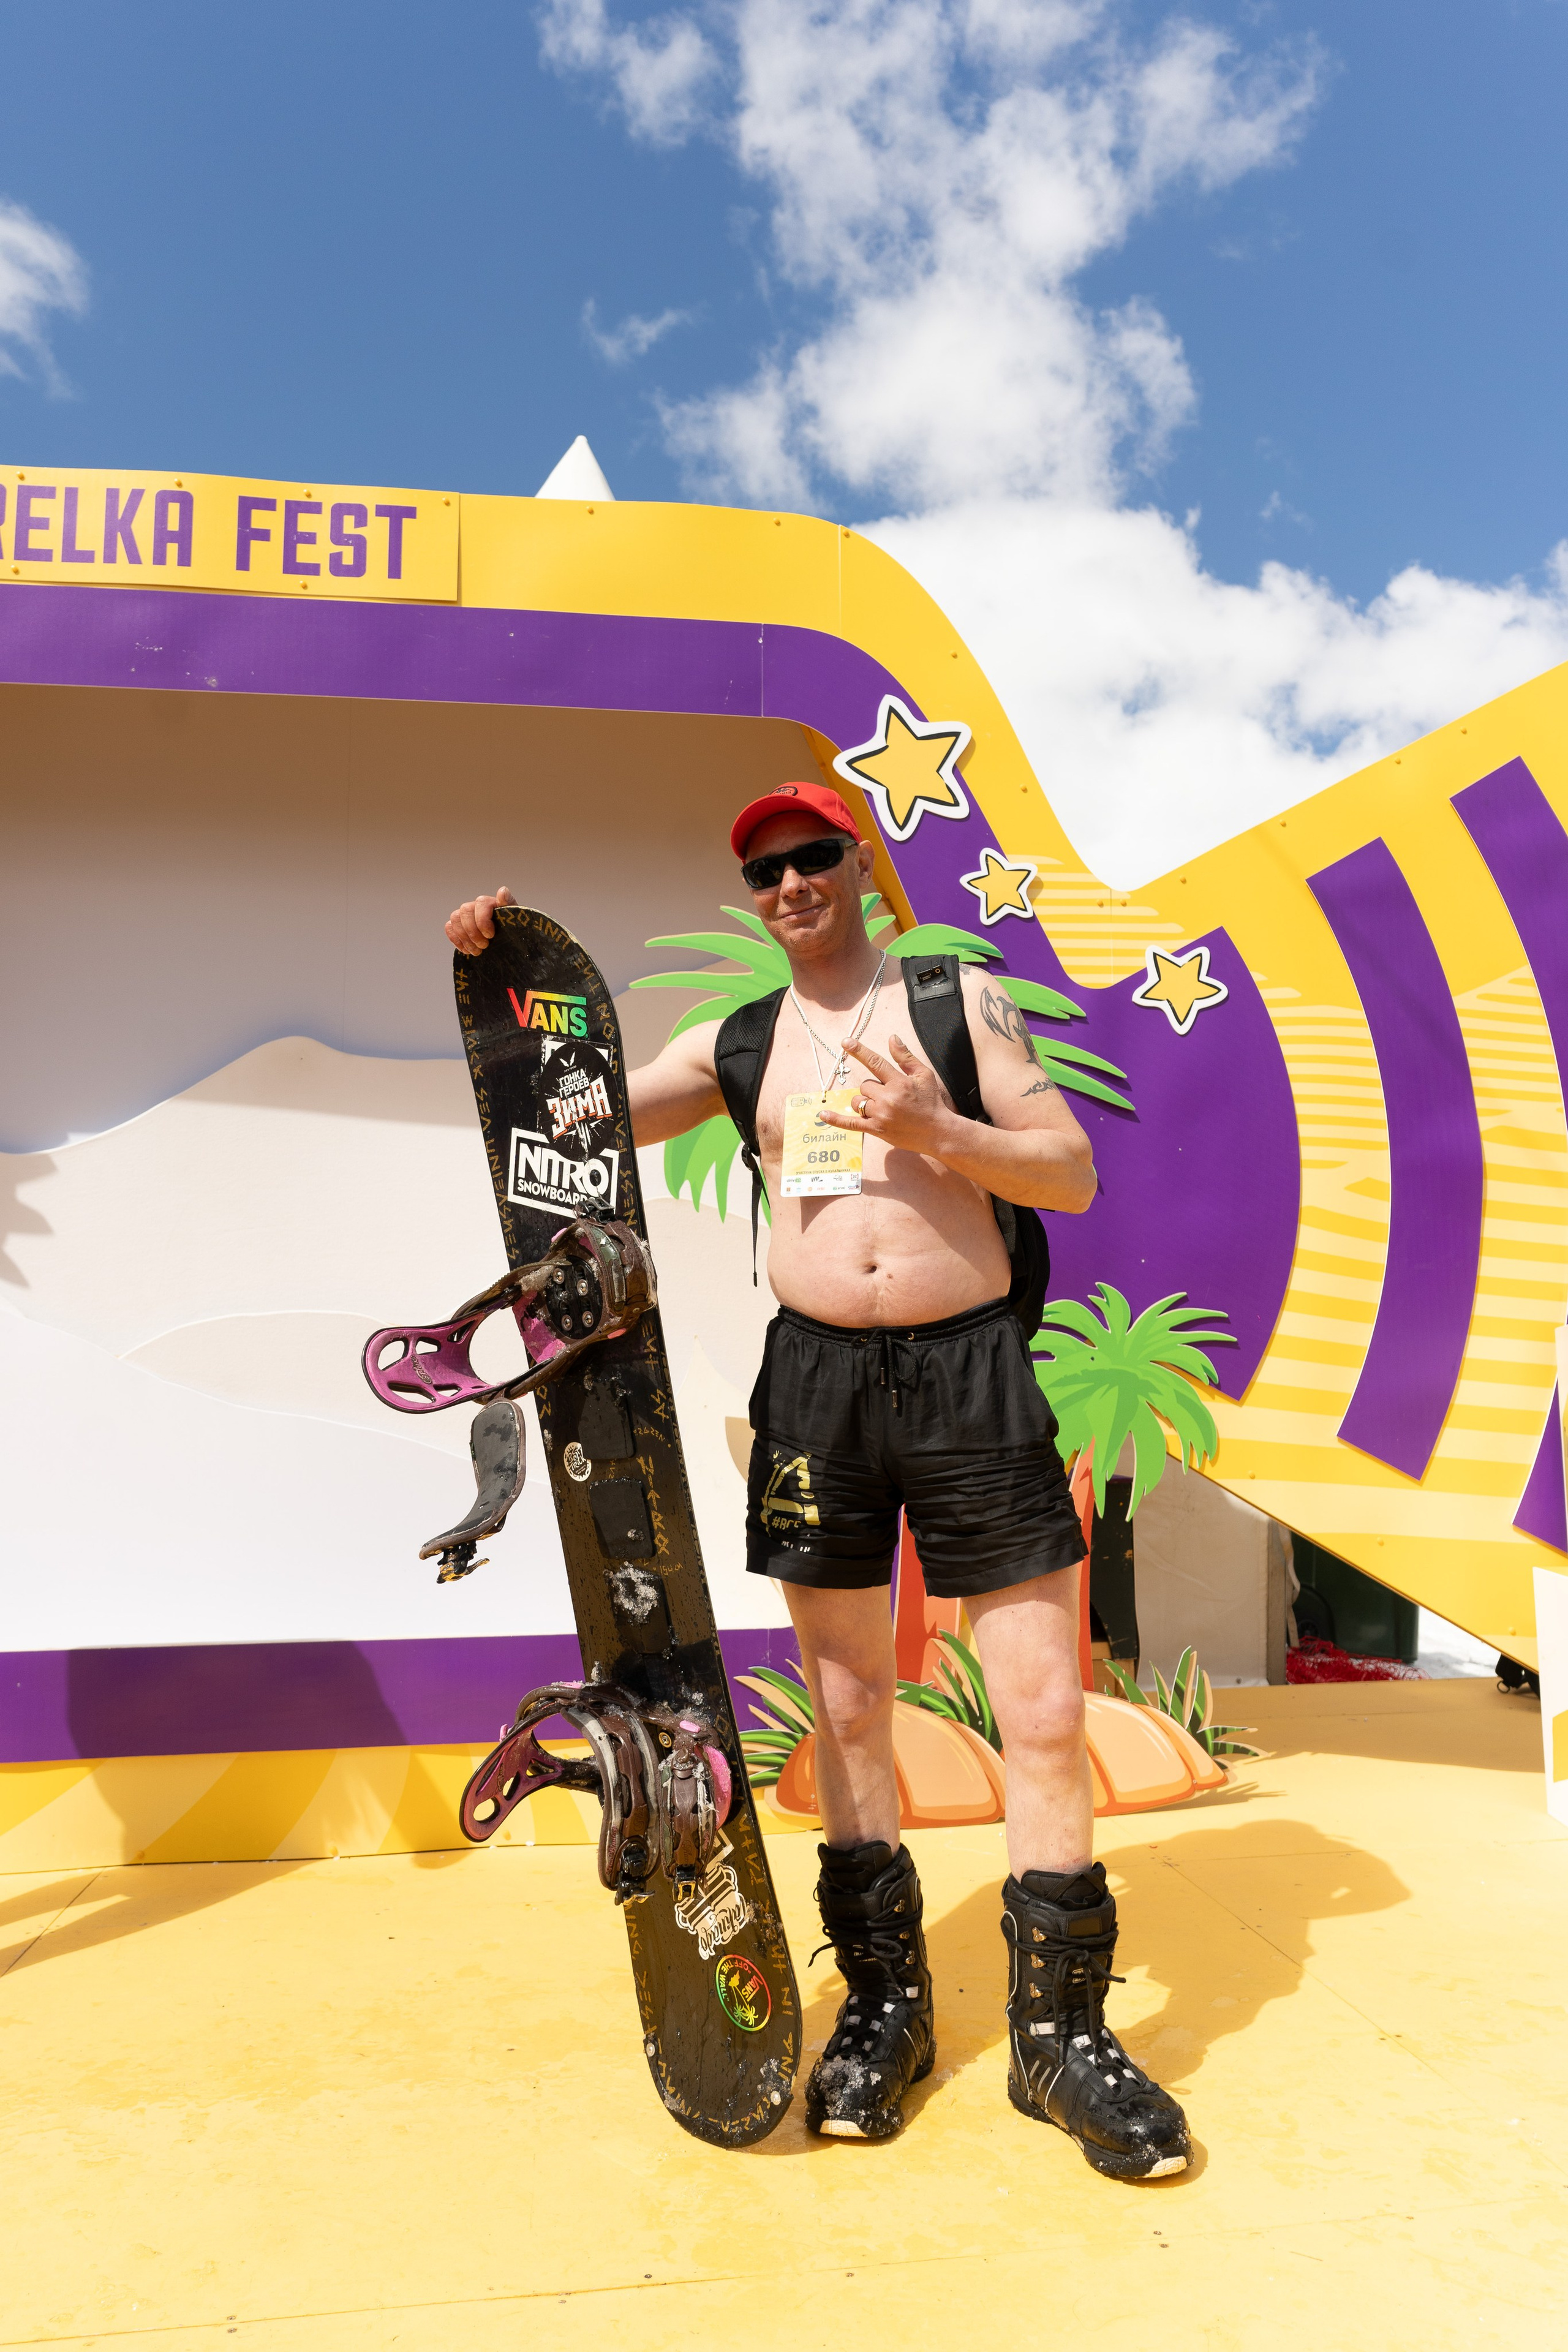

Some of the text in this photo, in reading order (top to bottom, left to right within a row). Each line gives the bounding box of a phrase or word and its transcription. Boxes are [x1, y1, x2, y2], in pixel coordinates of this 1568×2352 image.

[0, 483, 418, 579] ELKA FEST
[507, 987, 587, 1038] VANS
[559, 1068, 587, 1088] ГОНКА
[559, 1077, 590, 1098] ГЕРОЕВ
[546, 1075, 612, 1139] ЗИМА
[802, 1131, 846, 1144] билайн
[518, 1142, 609, 1197] NITRO
[807, 1150, 840, 1164] 680
[518, 1178, 596, 1206] SNOWBOARD
[721, 1959, 735, 1975] THE
[741, 1975, 763, 2002] VANS
